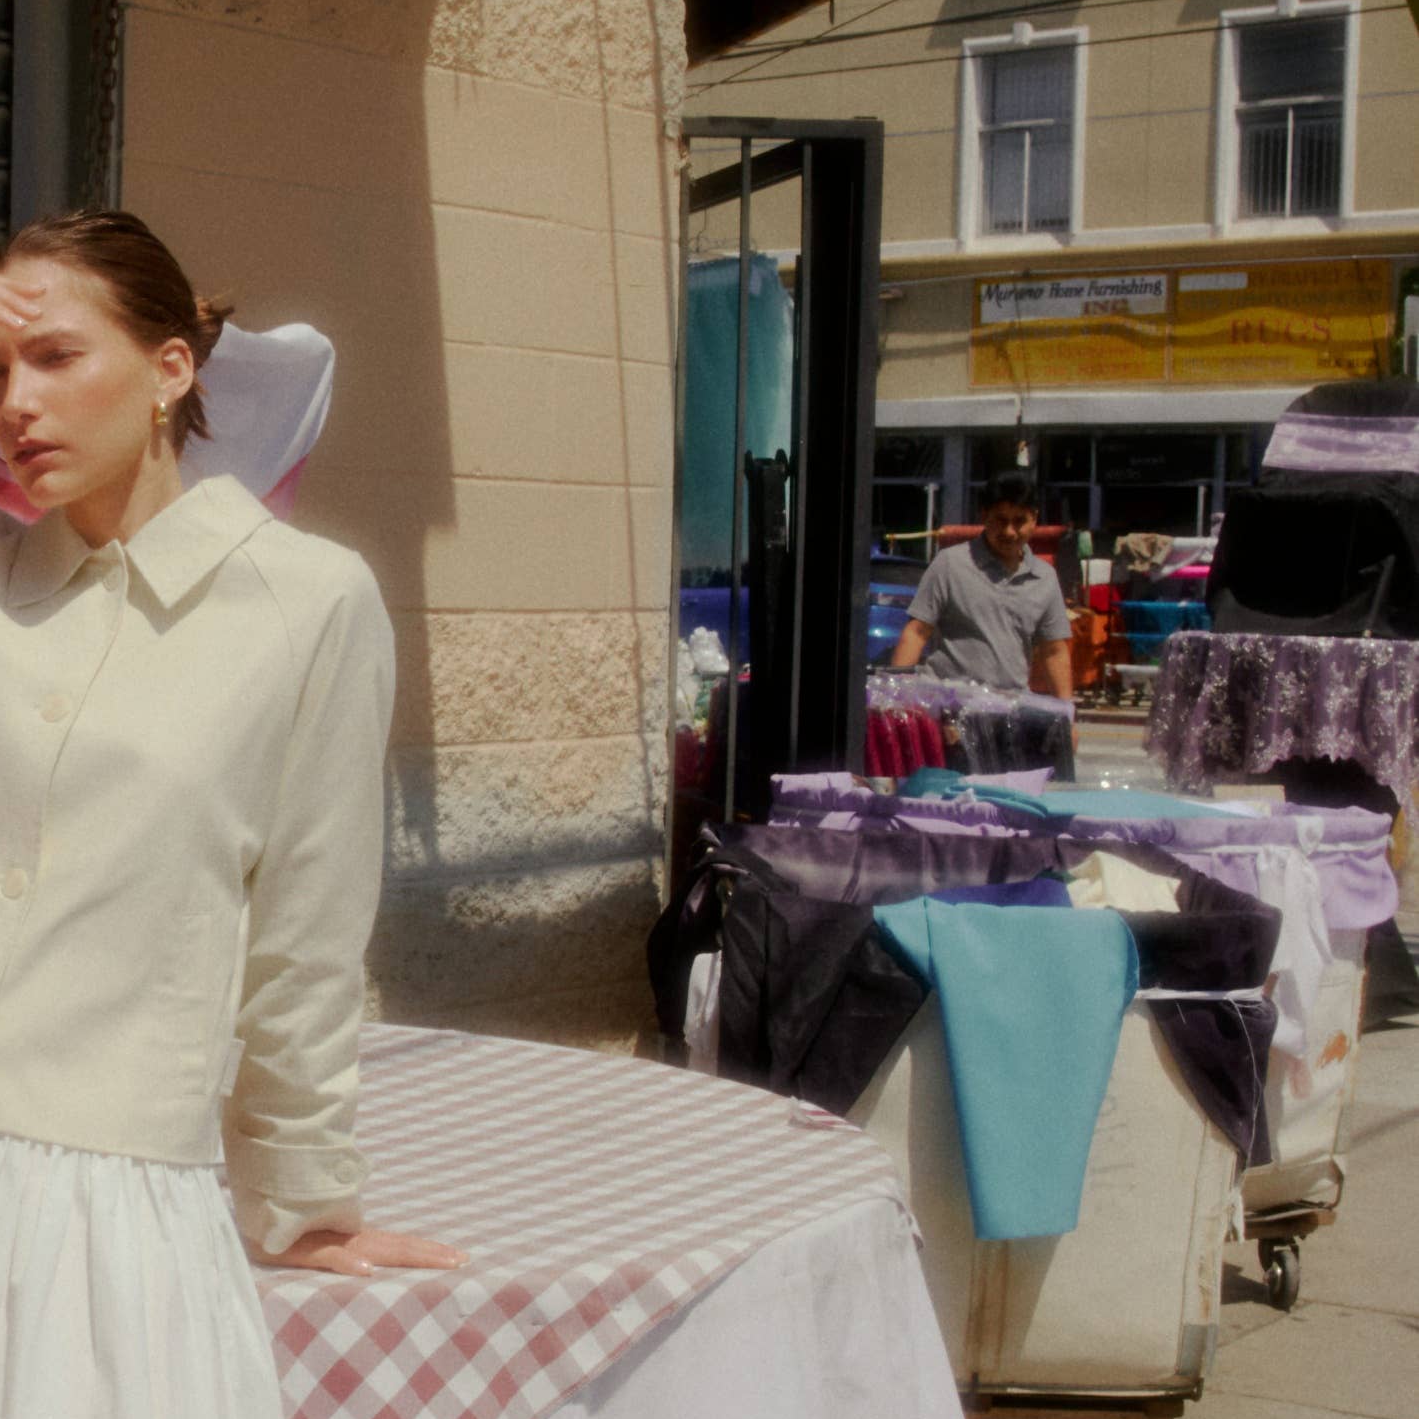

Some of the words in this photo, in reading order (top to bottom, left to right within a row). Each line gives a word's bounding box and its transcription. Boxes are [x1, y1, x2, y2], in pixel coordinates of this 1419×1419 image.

[1048, 281, 1085, 299] Home
[1087, 276, 1163, 297] Furnishing
[1230, 313, 1331, 346] RUGS
